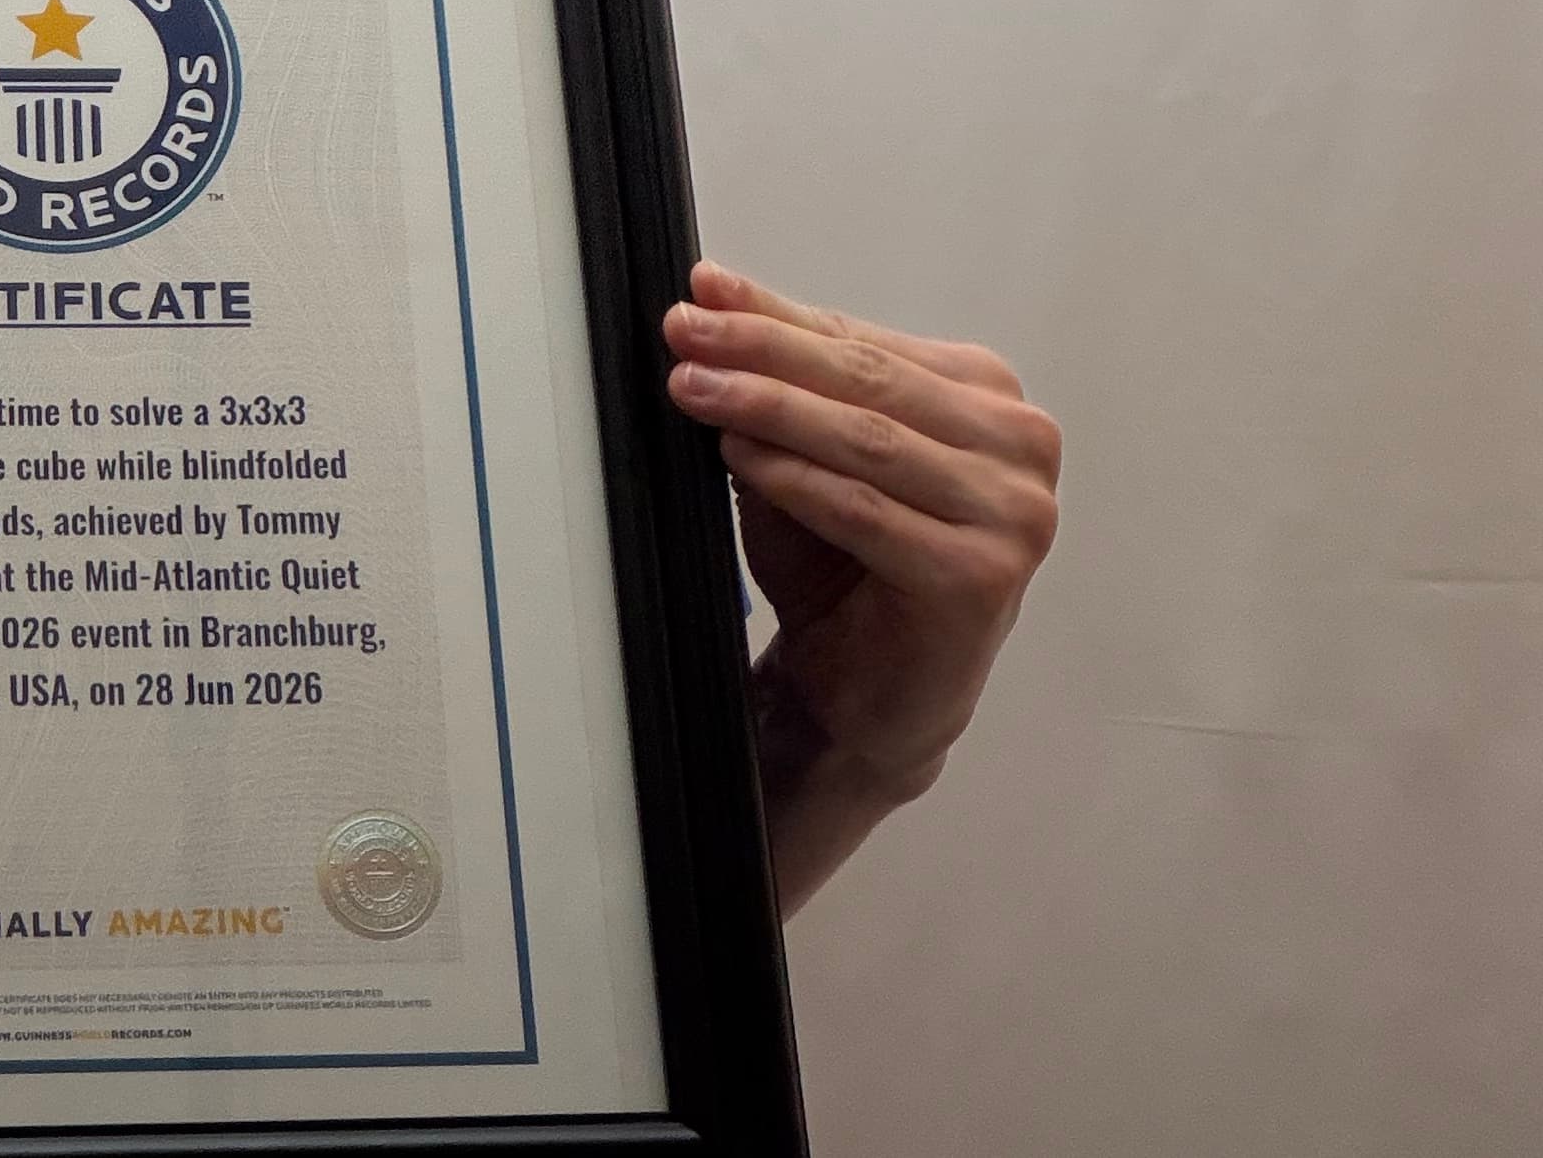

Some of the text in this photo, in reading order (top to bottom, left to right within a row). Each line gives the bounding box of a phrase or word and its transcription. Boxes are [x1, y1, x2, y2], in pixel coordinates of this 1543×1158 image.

[40, 54, 217, 231] RECORDS
[70, 398, 99, 426] to
[110, 396, 183, 426] solve
[194, 404, 209, 426] a
[220, 396, 305, 426] 3x3x3
[17, 450, 85, 481] cube
[97, 450, 171, 480] while
[182, 449, 347, 480] blindfolded
[54, 504, 183, 536] achieved
[194, 504, 226, 541] by
[236, 504, 340, 540] Tommy
[26, 561, 73, 592] the
[85, 560, 270, 592] Mid-Atlantic
[281, 559, 360, 595] Quiet
[71, 618, 152, 649] event
[163, 617, 190, 648] in
[201, 615, 385, 654] Branchburg,
[10, 674, 78, 711] USA,
[90, 683, 125, 706] on
[136, 673, 173, 706] 28
[184, 673, 234, 706] Jun
[245, 672, 322, 705] 2026
[108, 907, 285, 936] AMAZING
